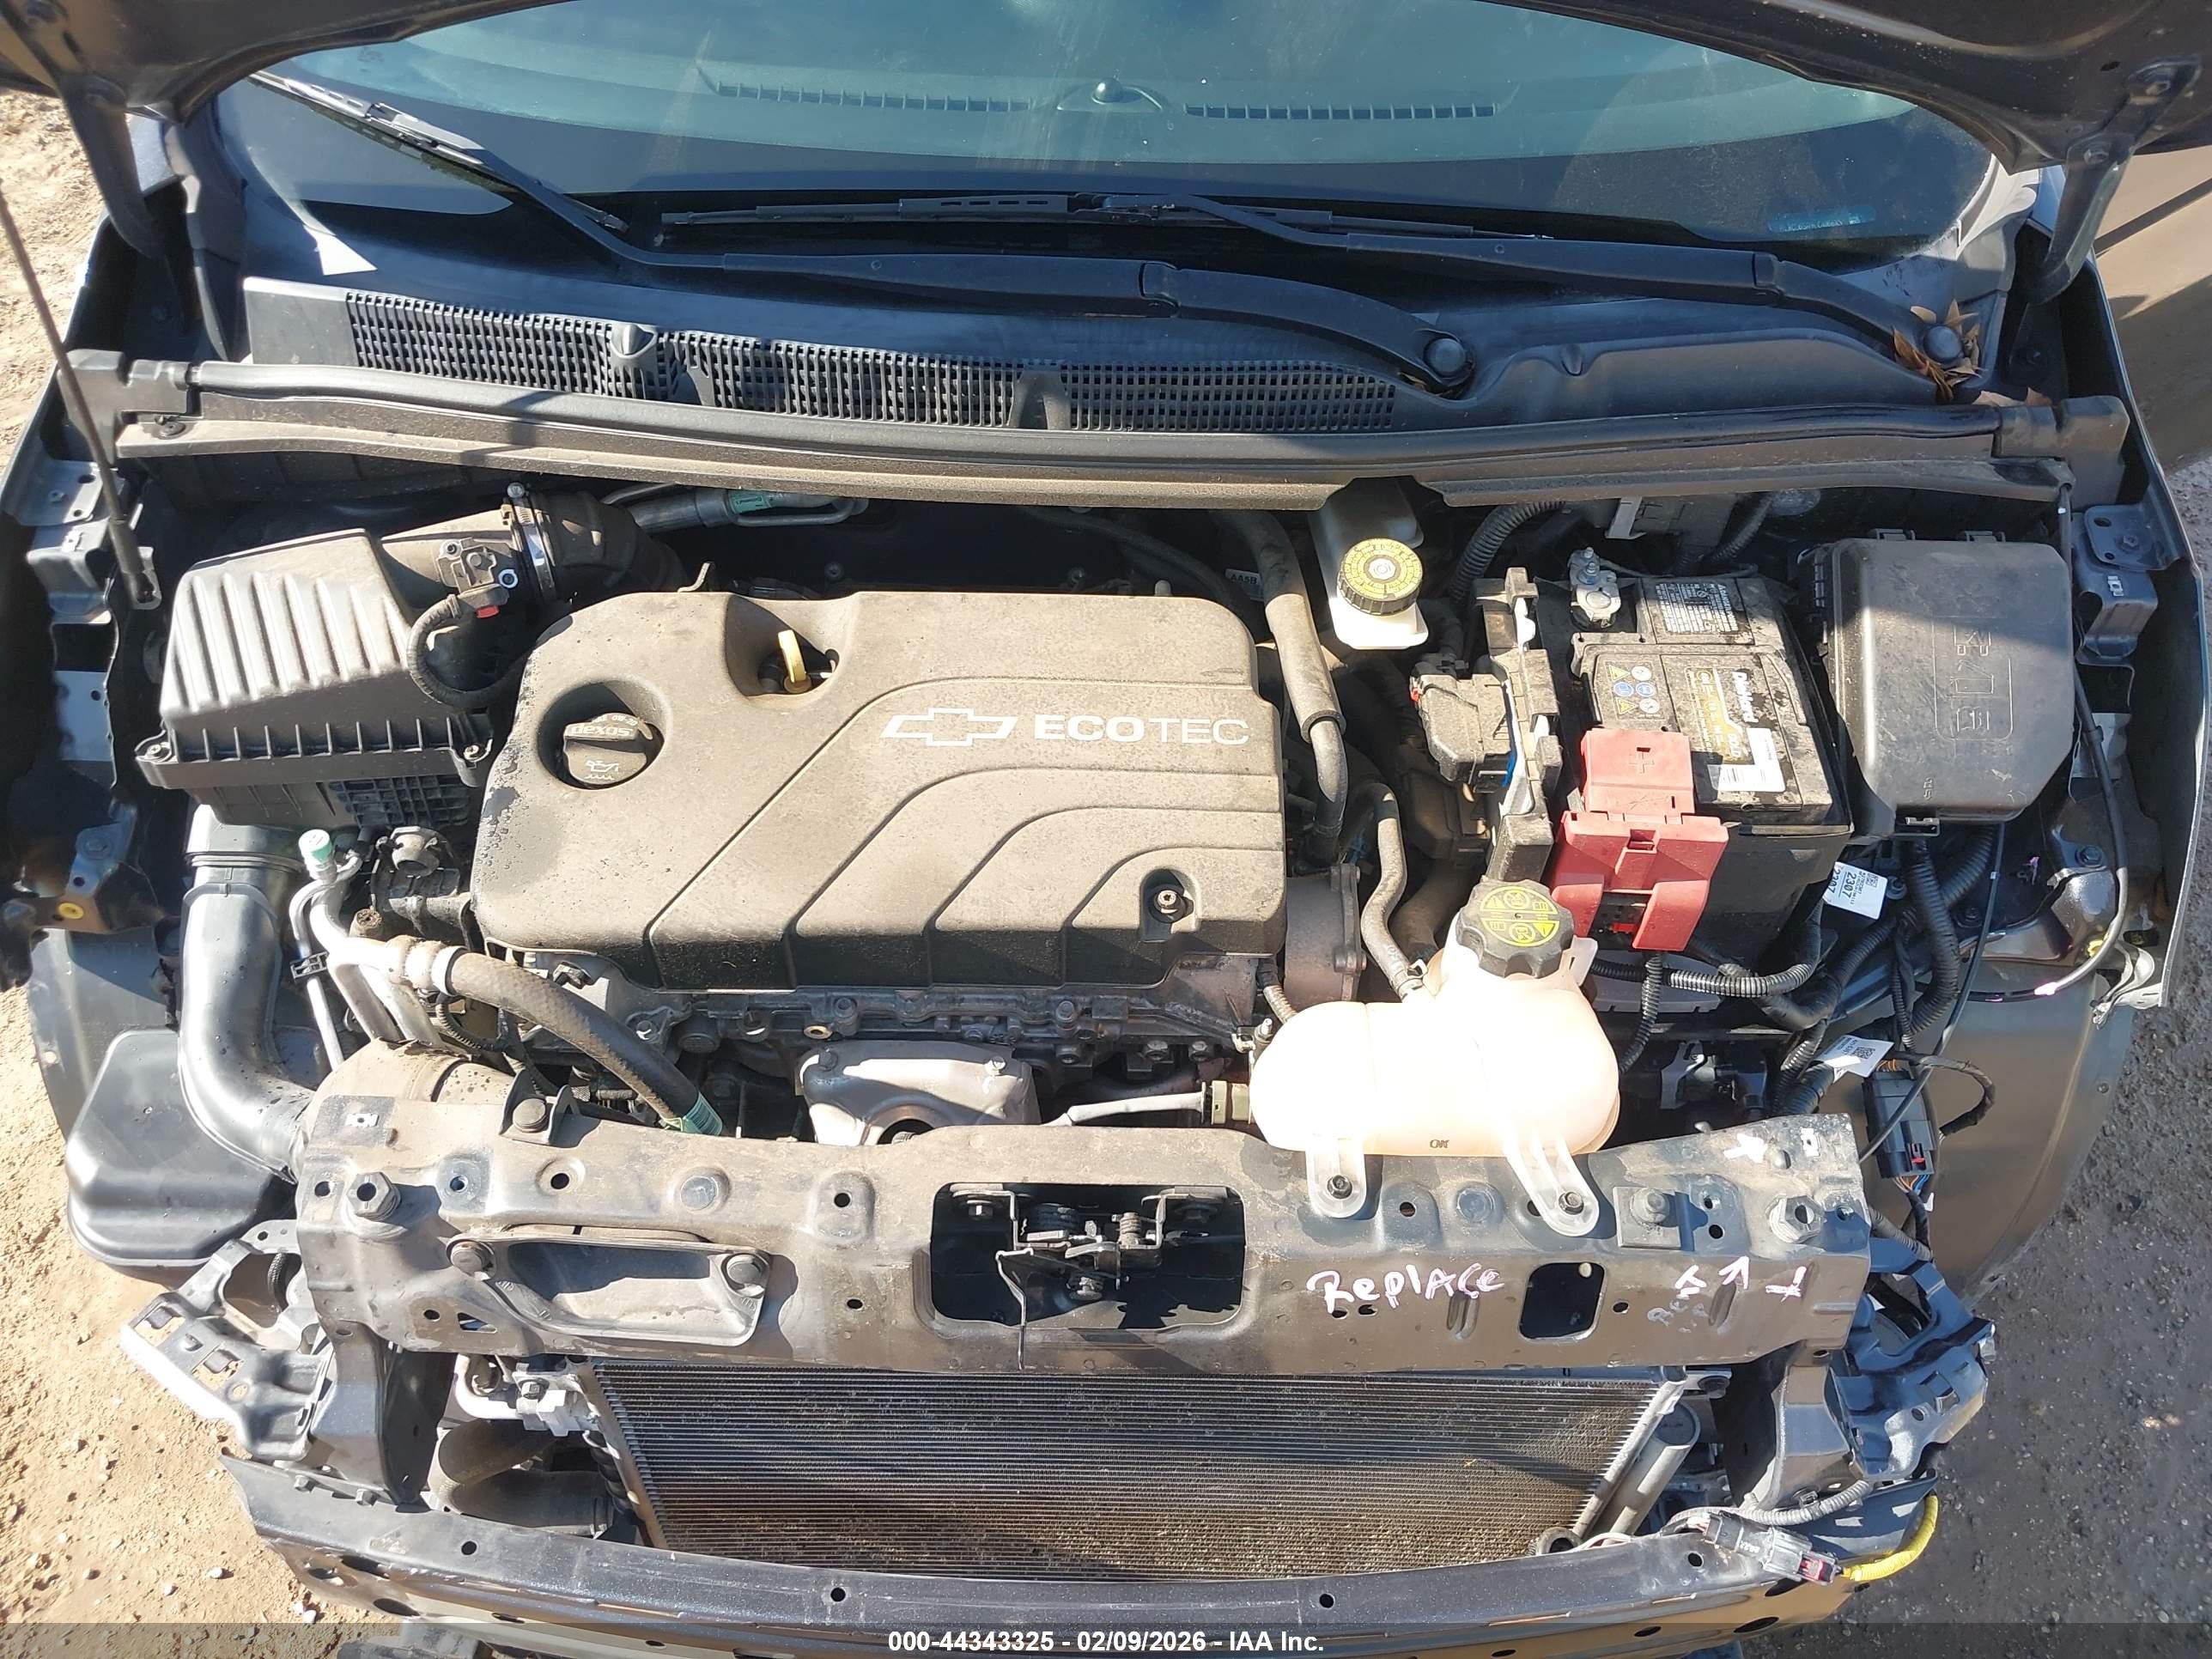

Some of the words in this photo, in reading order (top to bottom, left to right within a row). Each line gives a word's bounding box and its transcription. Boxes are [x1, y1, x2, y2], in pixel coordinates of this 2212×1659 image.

[611, 714, 638, 726] 0W-20
[1034, 714, 1249, 745] ECOTEC
[571, 725, 633, 737] dexos
[1842, 871, 1857, 898] 2307
